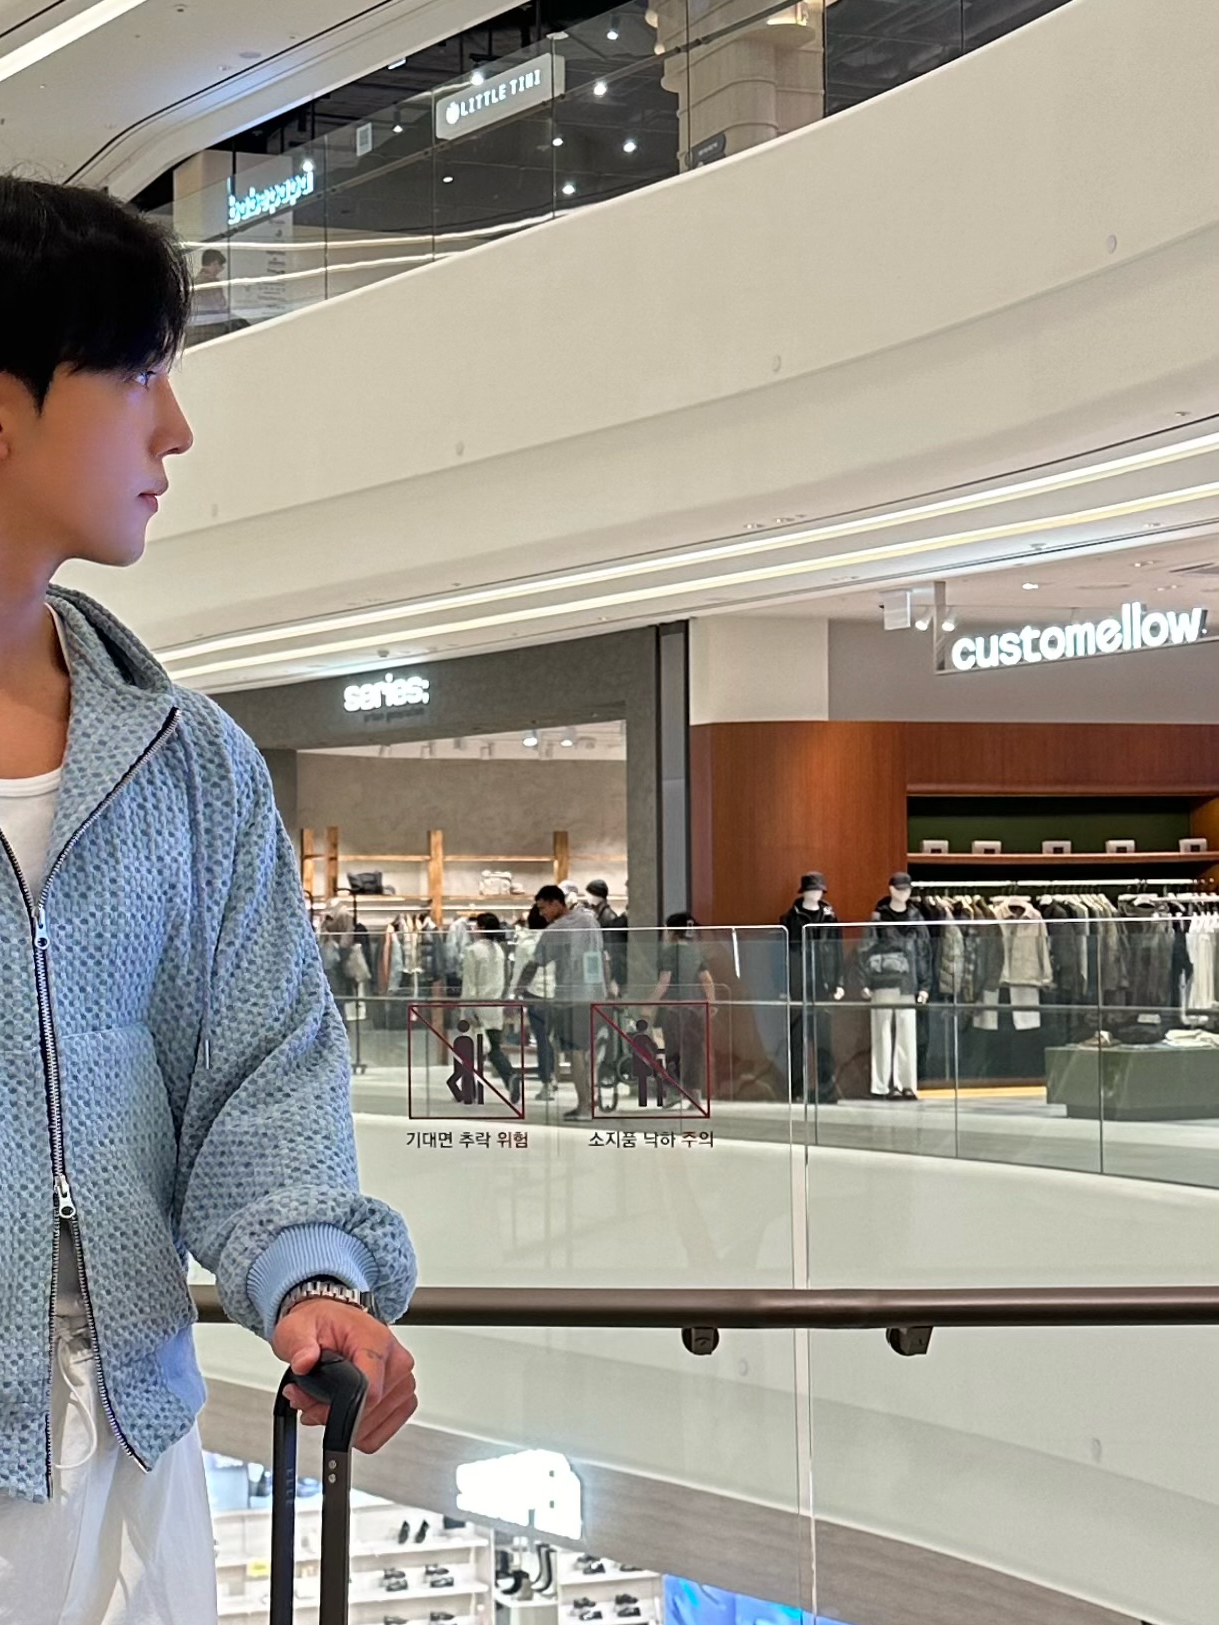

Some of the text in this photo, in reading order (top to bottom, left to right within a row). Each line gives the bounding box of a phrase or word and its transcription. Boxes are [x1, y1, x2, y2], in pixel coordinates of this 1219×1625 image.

[460, 83, 506, 116] LITTLE
[952, 601, 1203, 671] customellow
[406, 1131, 529, 1149] 기대면 추락 위험
[588, 1130, 714, 1148] 소지품 낙하 주의
